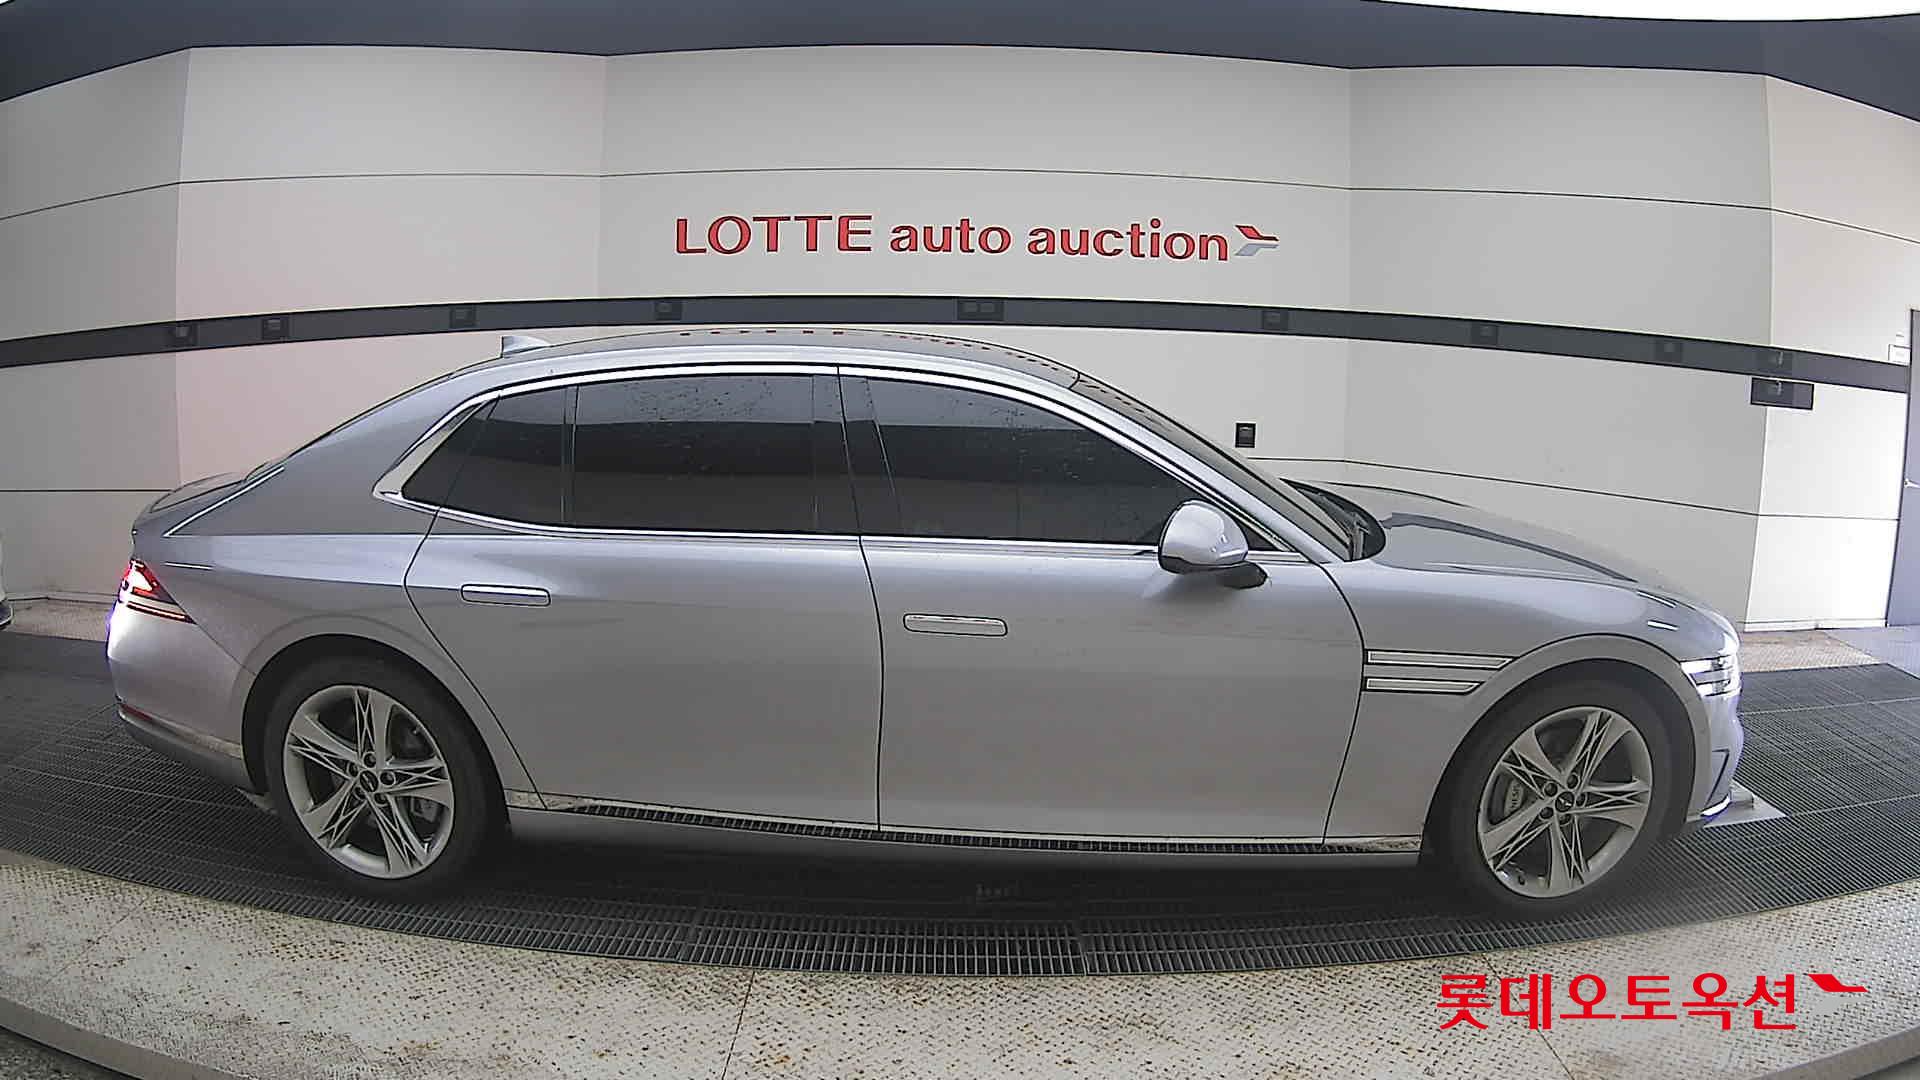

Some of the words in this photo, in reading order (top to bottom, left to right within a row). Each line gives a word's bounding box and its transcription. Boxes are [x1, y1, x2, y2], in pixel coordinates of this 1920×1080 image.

[676, 216, 873, 254] LOTTE
[890, 218, 1012, 252] auto
[1028, 219, 1229, 261] auction
